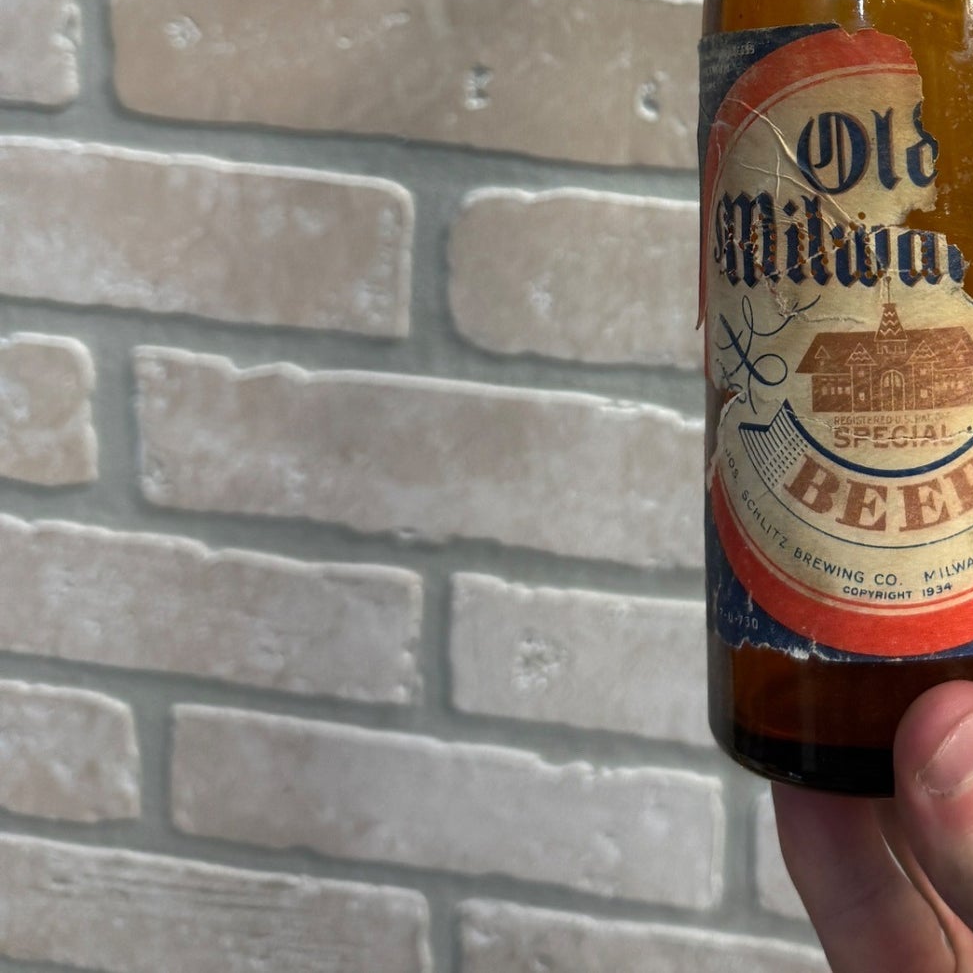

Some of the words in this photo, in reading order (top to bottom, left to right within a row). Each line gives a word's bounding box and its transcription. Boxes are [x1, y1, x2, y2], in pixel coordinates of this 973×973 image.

[796, 101, 939, 195] Old
[834, 415, 894, 426] REGISTERED
[834, 423, 954, 449] SPECIAL
[742, 489, 788, 549] SCHLITZ
[794, 546, 865, 584] BREWING
[874, 573, 903, 586] CO.
[843, 585, 913, 600] COPYRIGHT
[922, 582, 953, 597] 1934
